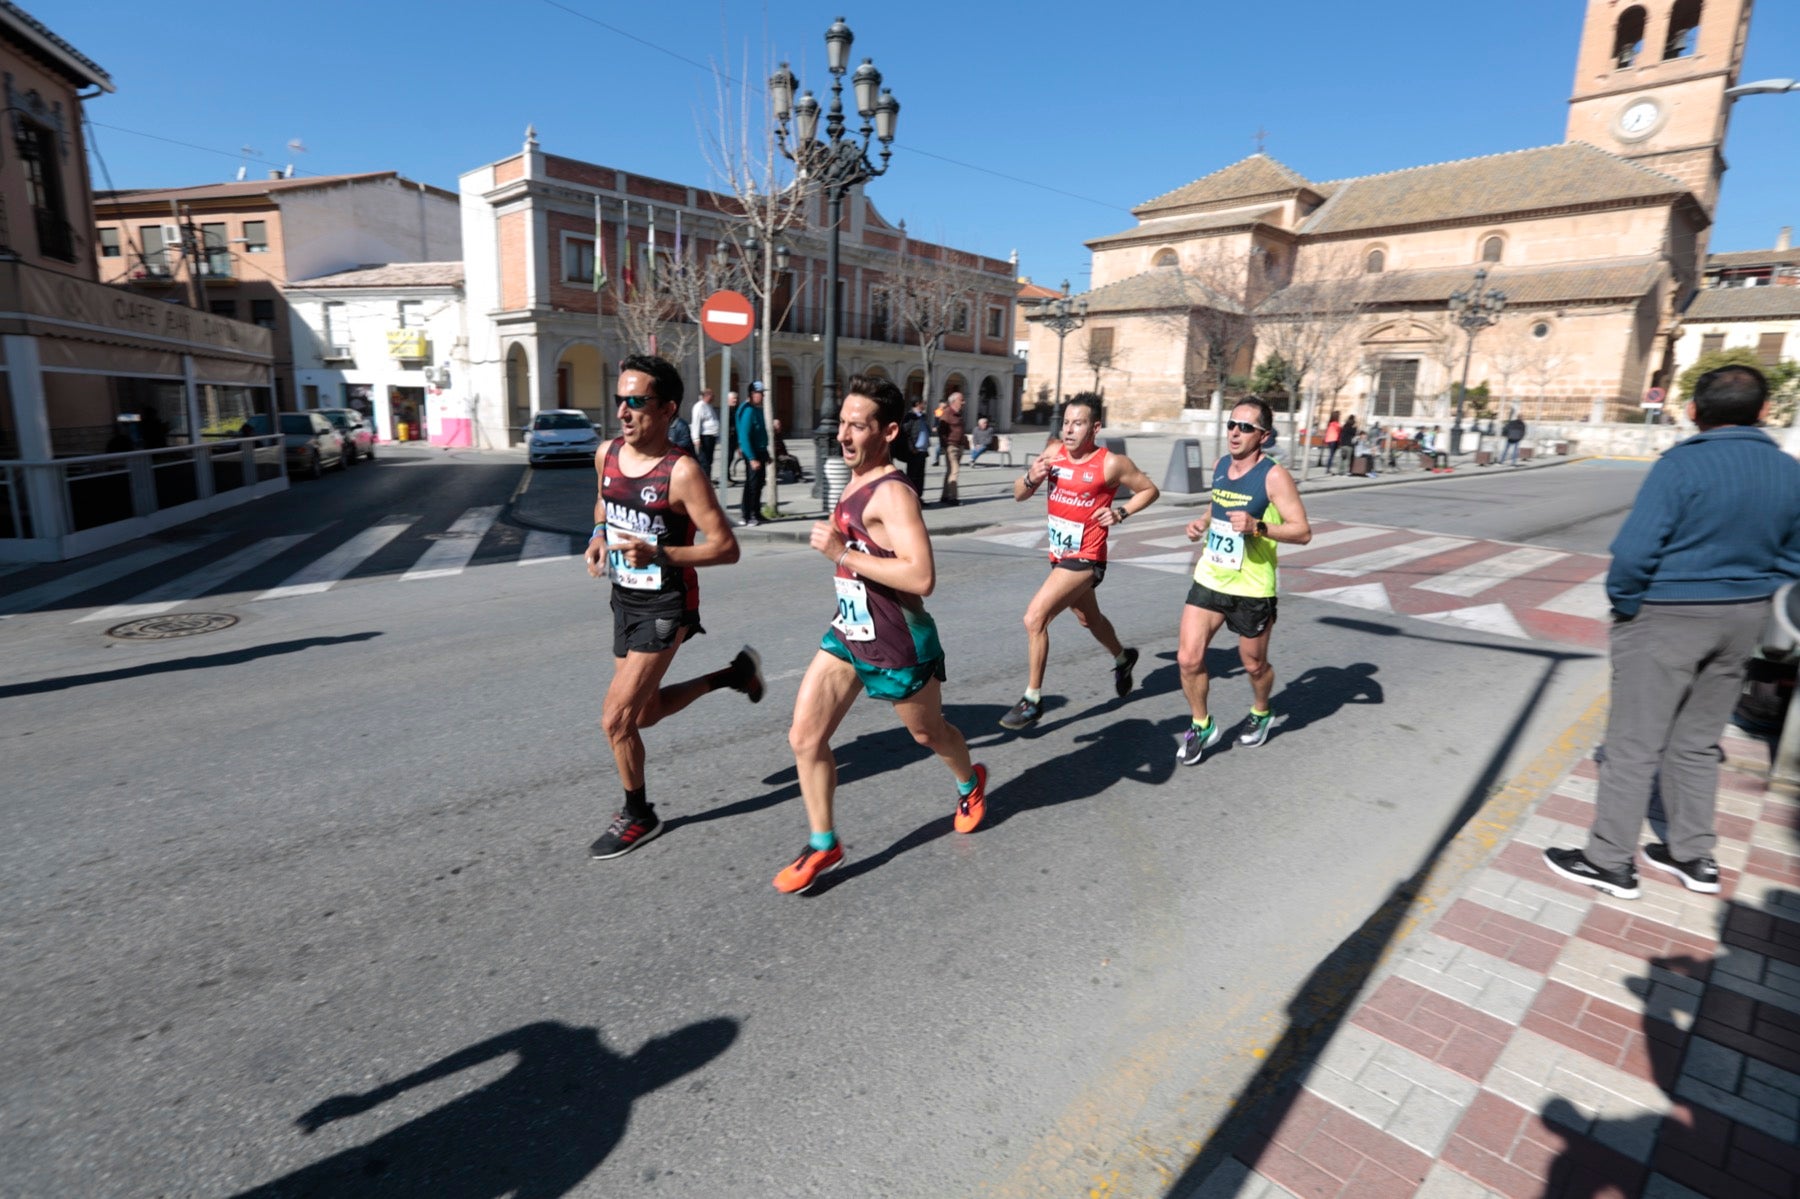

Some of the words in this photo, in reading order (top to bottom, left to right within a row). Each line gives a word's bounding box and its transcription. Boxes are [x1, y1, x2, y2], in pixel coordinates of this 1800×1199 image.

[603, 500, 666, 529] ANADA
[1051, 528, 1072, 548] 714
[1211, 533, 1234, 553] 773
